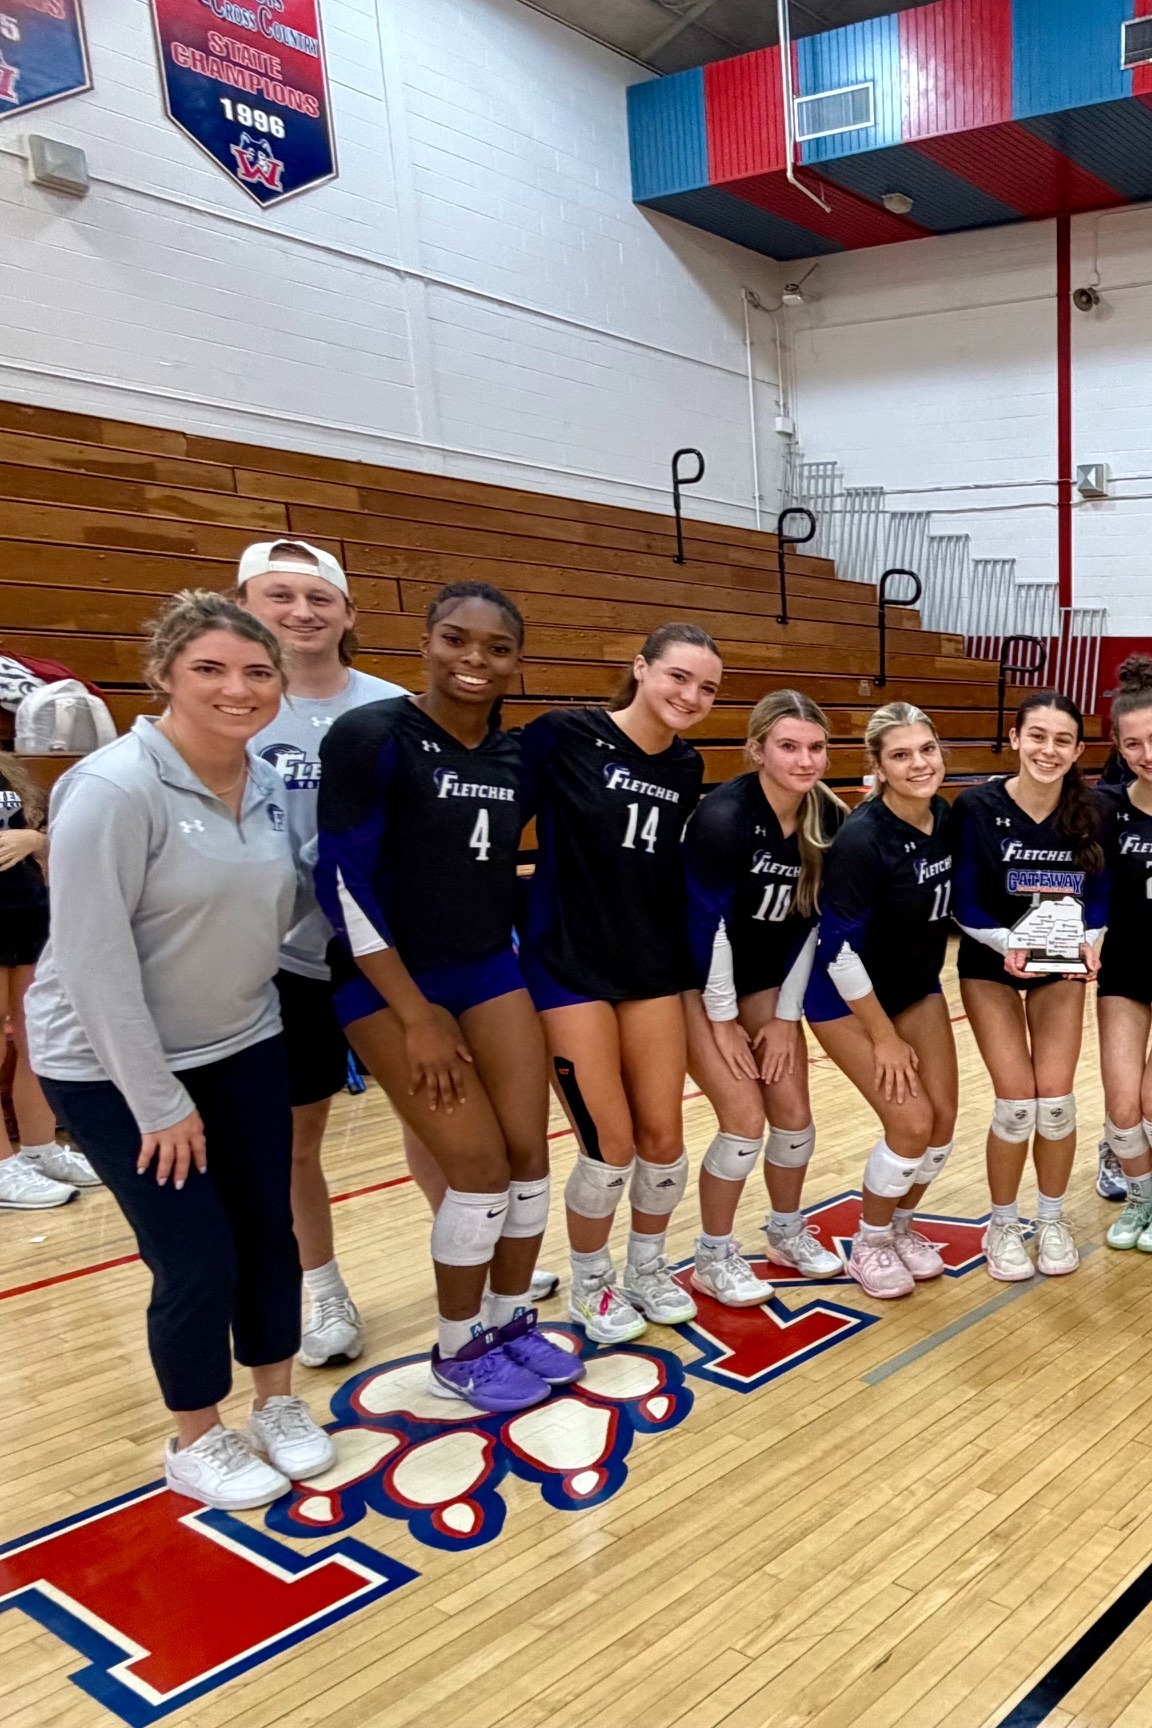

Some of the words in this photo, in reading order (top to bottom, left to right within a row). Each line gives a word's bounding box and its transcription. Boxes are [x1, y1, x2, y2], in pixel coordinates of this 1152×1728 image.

[257, 5, 319, 58] COUNTRY
[207, 30, 283, 80] STATE
[171, 41, 320, 118] CHAMPIONS
[220, 97, 286, 139] 1996
[438, 771, 515, 802] FLETCHER
[605, 768, 680, 804] FLETCHER
[469, 808, 491, 861] 4
[621, 802, 660, 854] 14
[750, 854, 802, 878] FLETCH
[1007, 869, 1085, 895] GATEWAY
[751, 883, 793, 922] 10
[928, 879, 952, 921] 11
